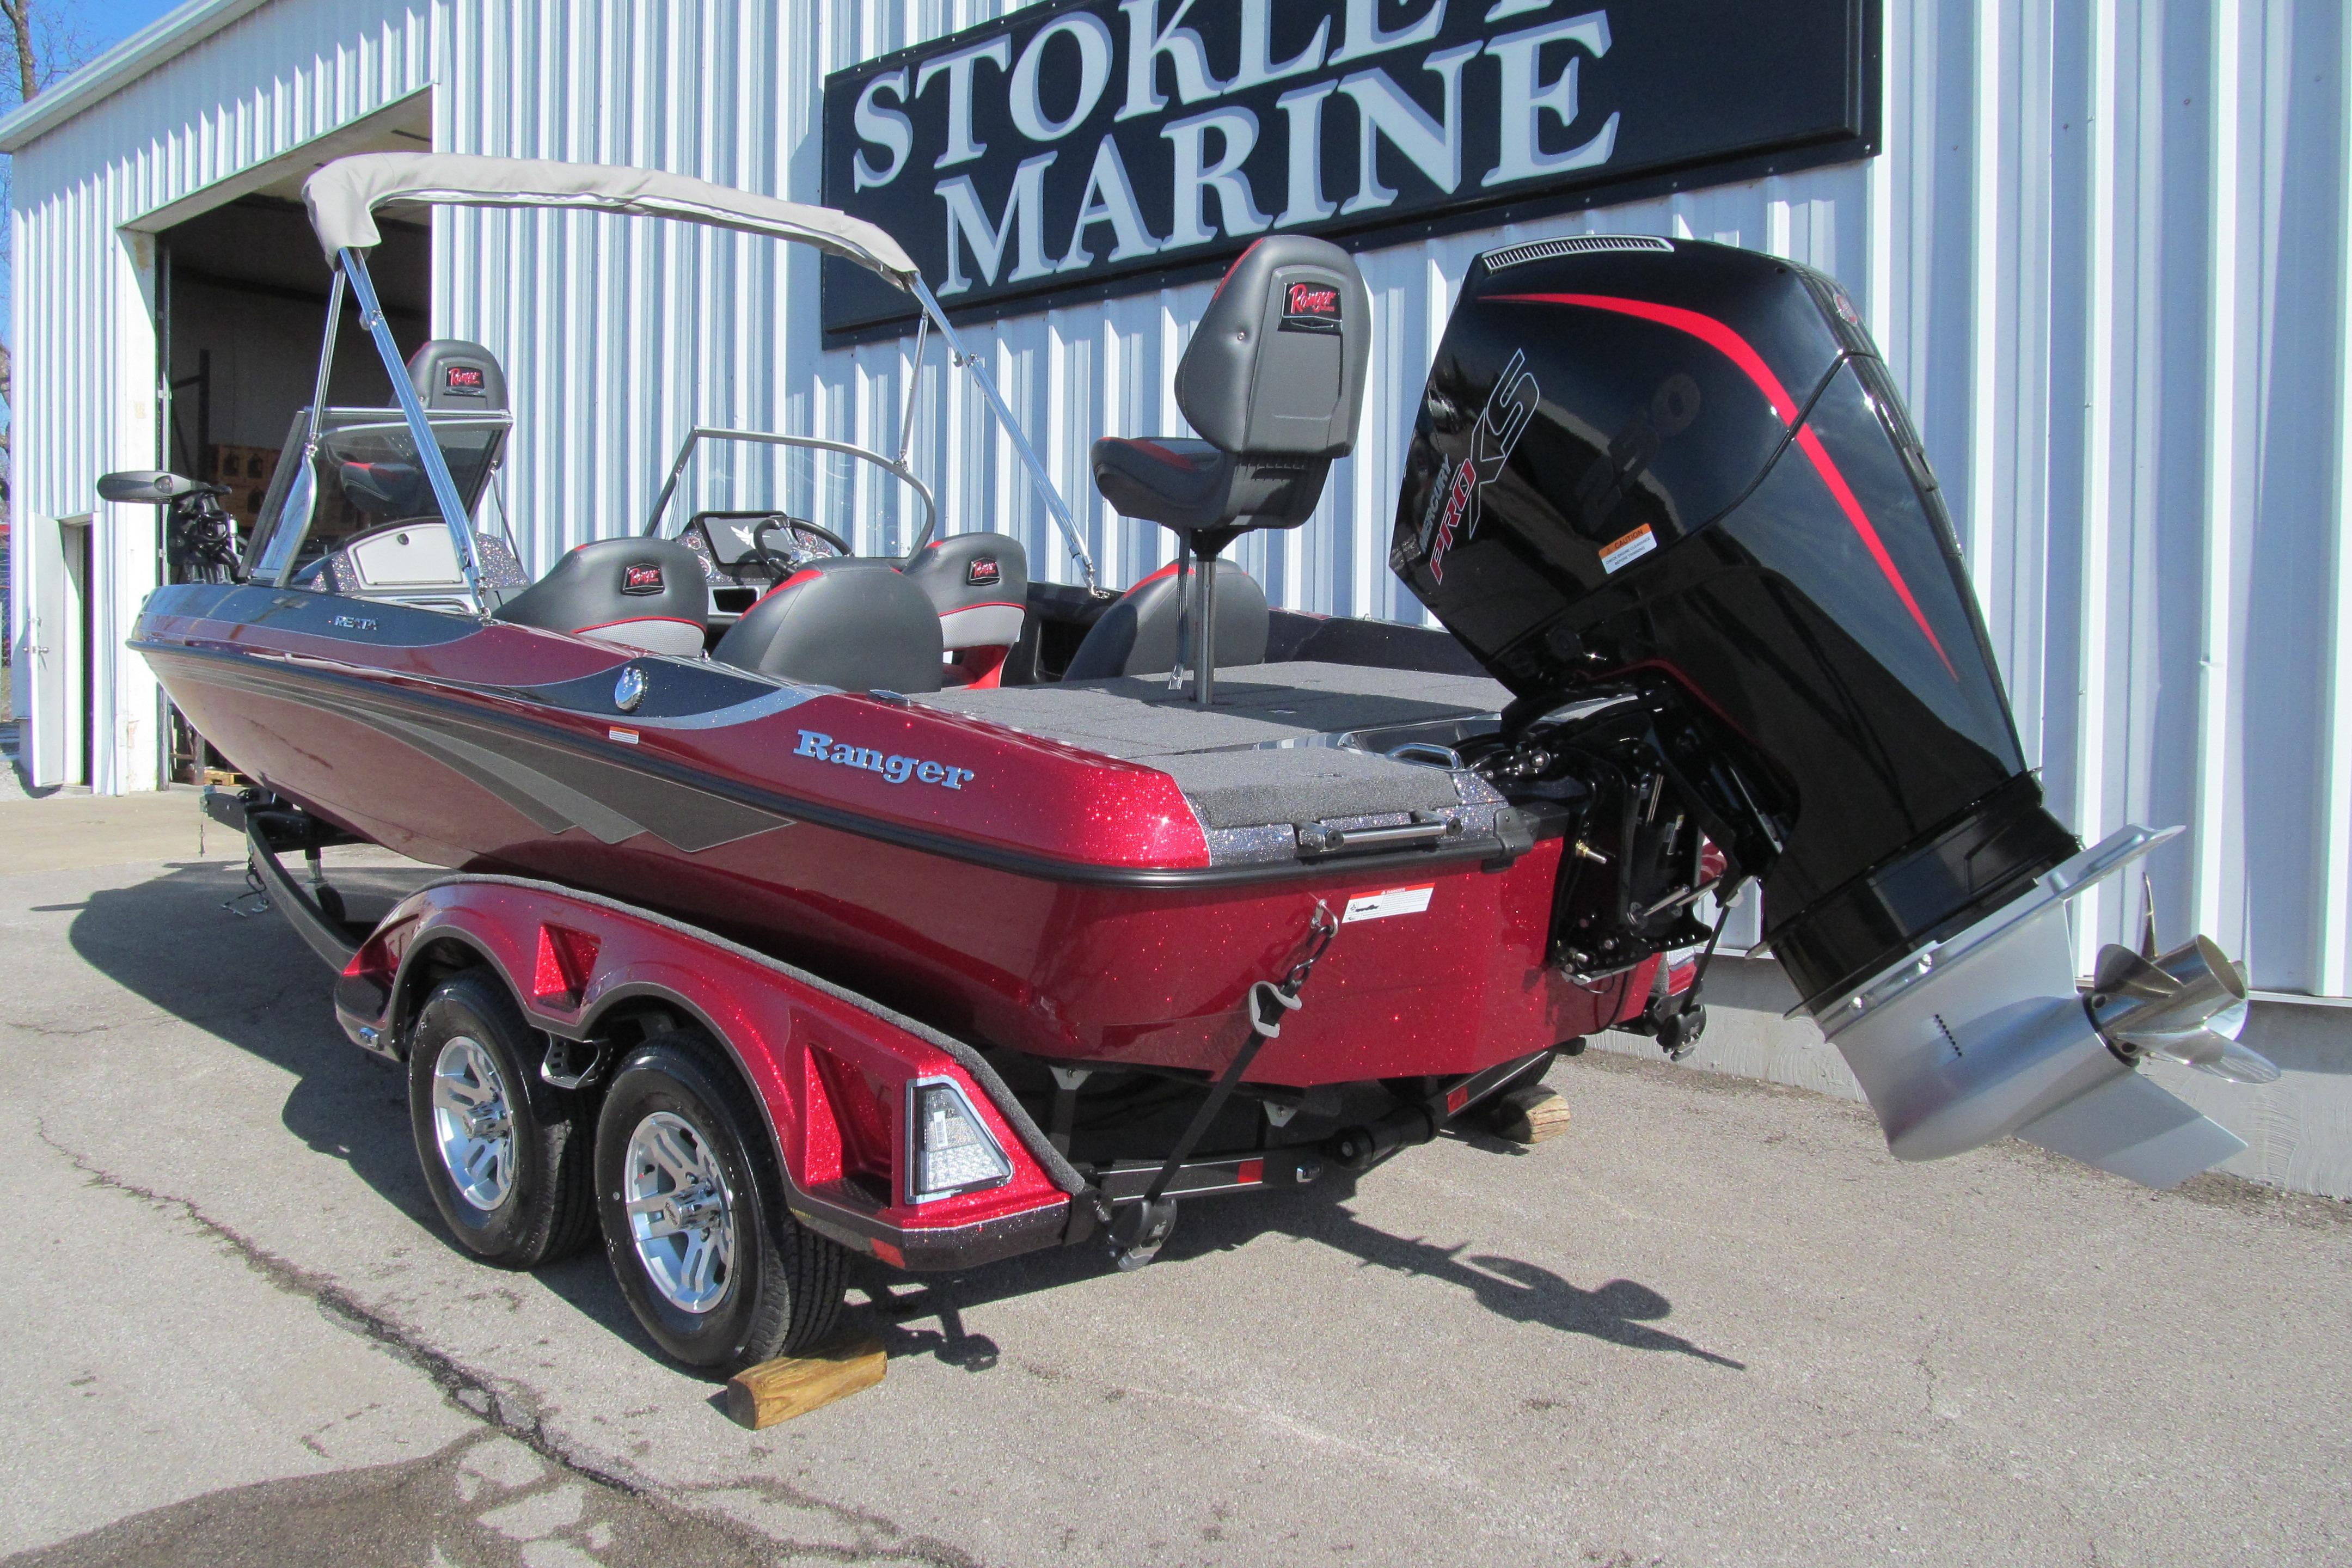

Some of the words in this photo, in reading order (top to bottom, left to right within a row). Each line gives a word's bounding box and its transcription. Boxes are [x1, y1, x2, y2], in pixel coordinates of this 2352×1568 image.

[854, 0, 1553, 193] STOKL
[934, 10, 1620, 298] MARINE
[1289, 283, 1336, 314] Ranger
[1419, 453, 1451, 554] MERCURY
[1430, 458, 1476, 585] PRO
[1614, 529, 1643, 549] CAUTION
[793, 728, 975, 790] Ranger
